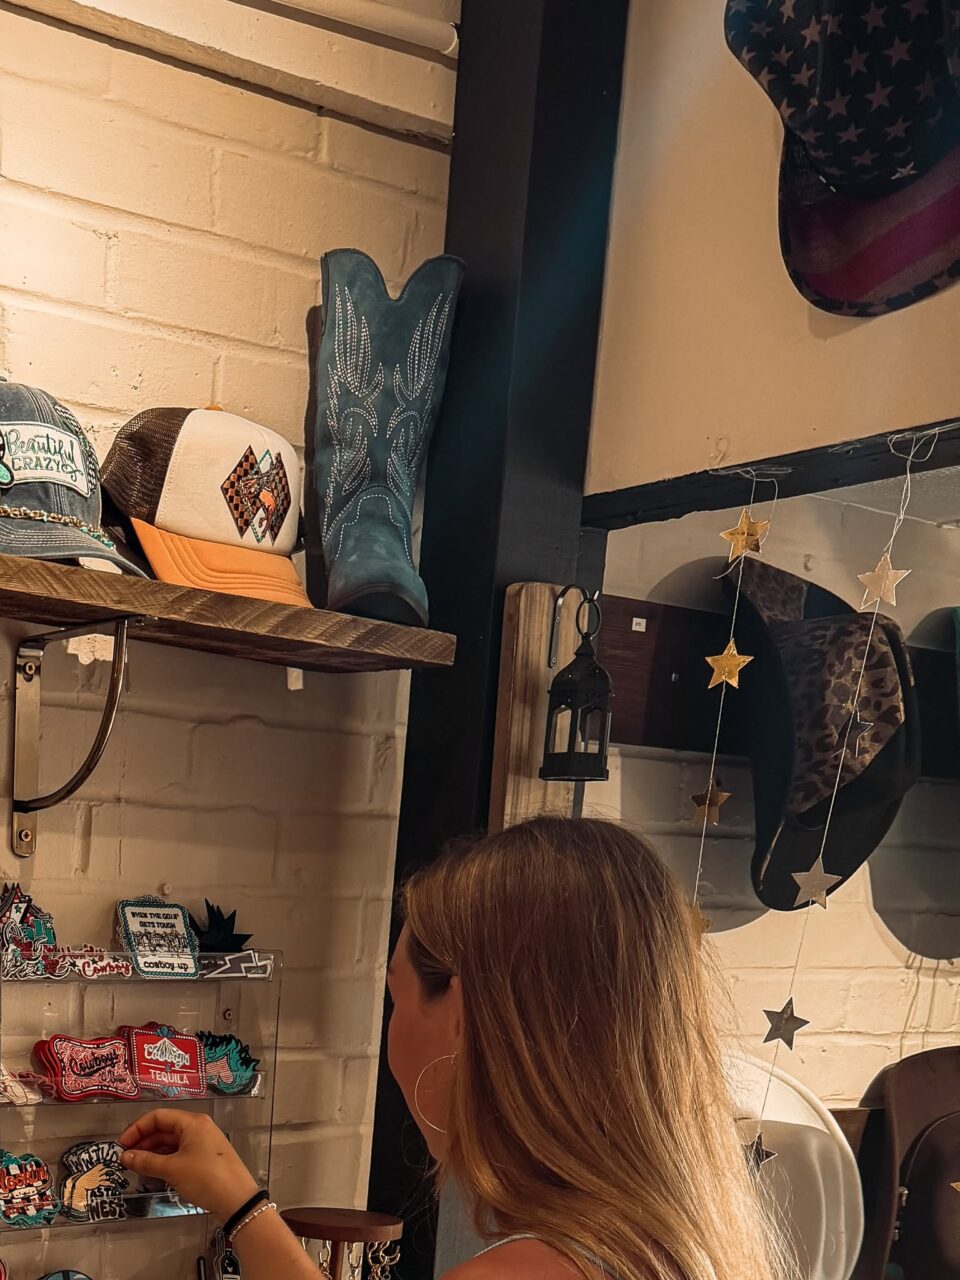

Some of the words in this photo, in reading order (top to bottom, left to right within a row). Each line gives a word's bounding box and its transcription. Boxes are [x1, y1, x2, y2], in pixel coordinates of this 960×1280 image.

[4, 429, 82, 477] Beautiful
[11, 456, 61, 472] CRAZY
[82, 961, 132, 978] Cowboy
[148, 1069, 190, 1085] TEQUILA
[88, 1200, 126, 1221] WEST
